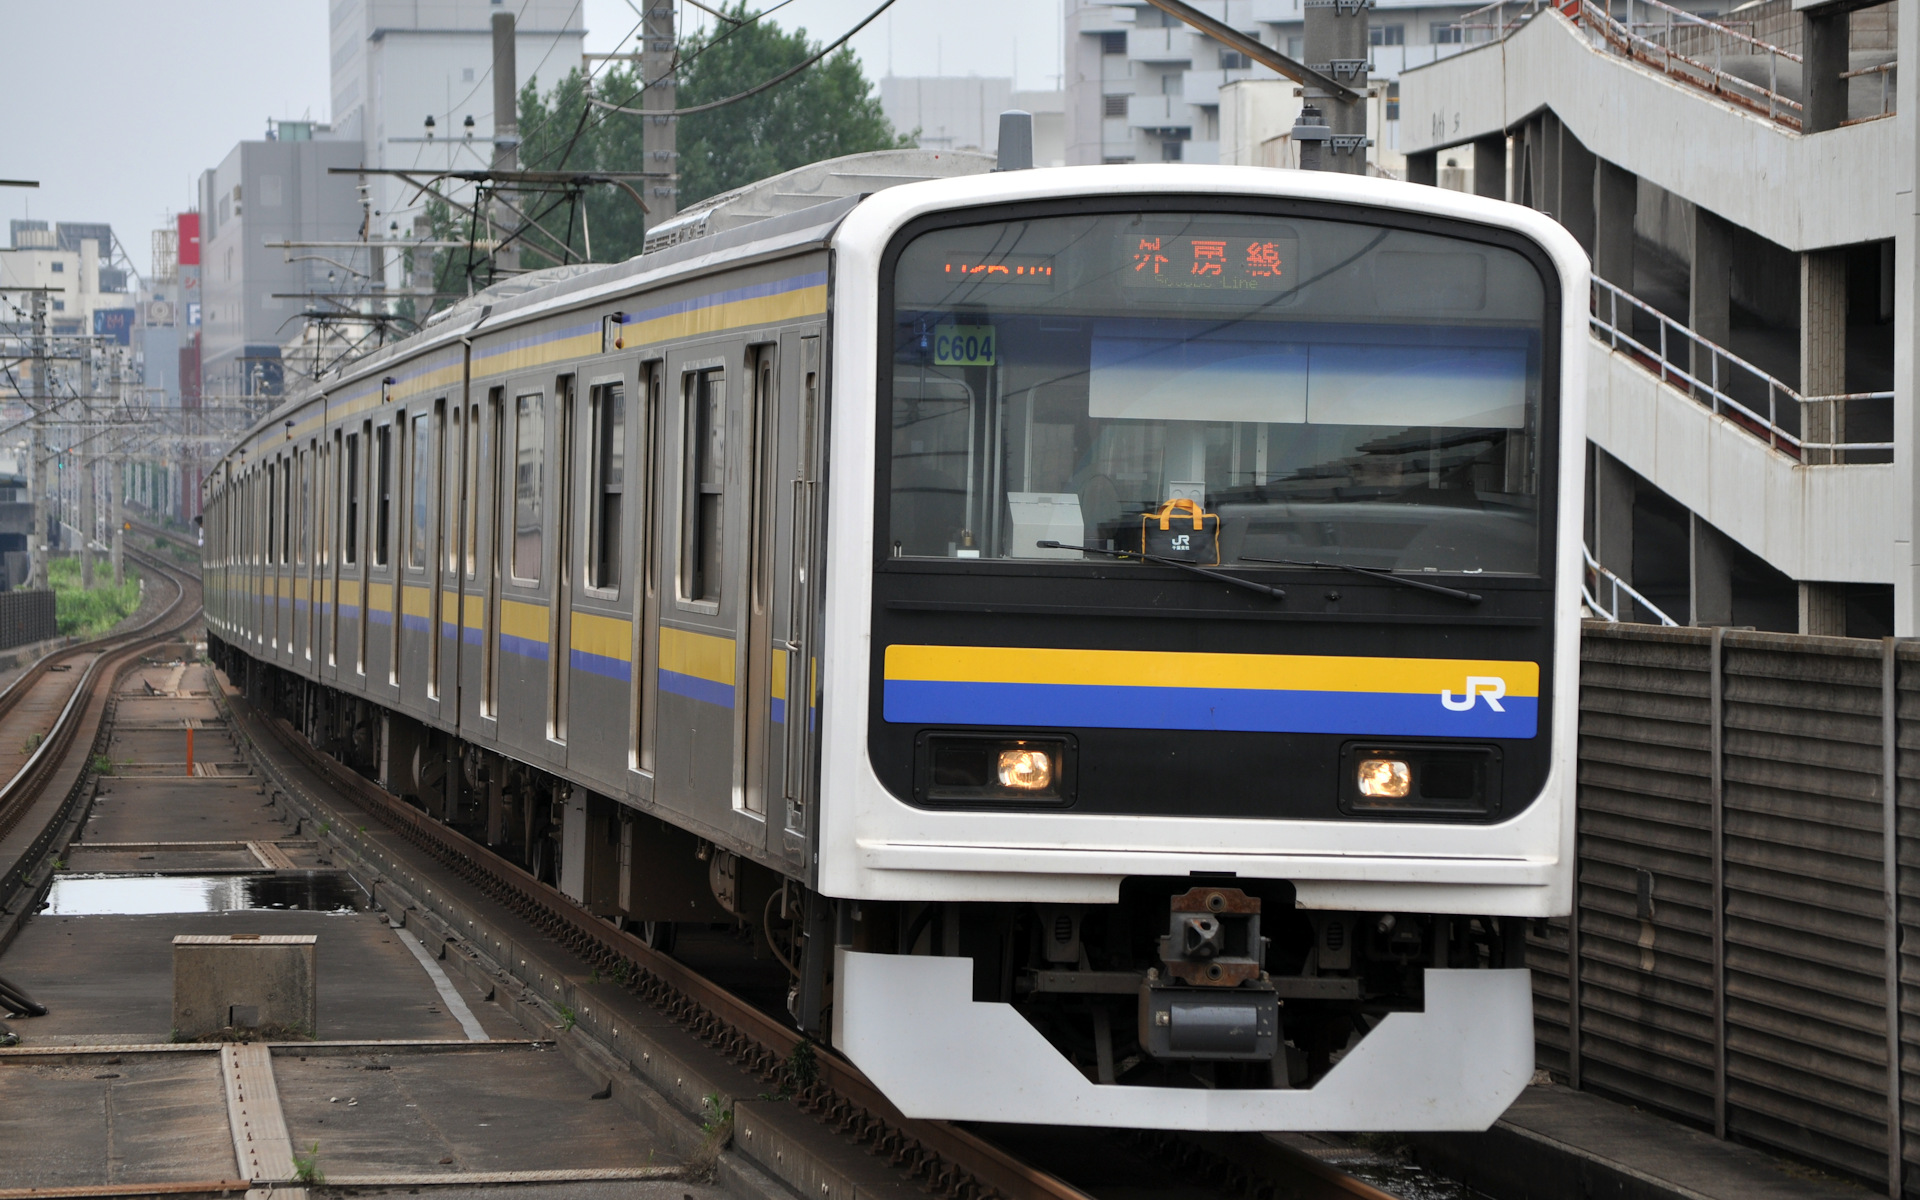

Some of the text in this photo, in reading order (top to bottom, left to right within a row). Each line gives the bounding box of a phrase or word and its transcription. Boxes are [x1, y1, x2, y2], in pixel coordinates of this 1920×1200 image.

[936, 335, 993, 362] C604
[1171, 534, 1190, 545] JR
[1441, 676, 1506, 712] JR
